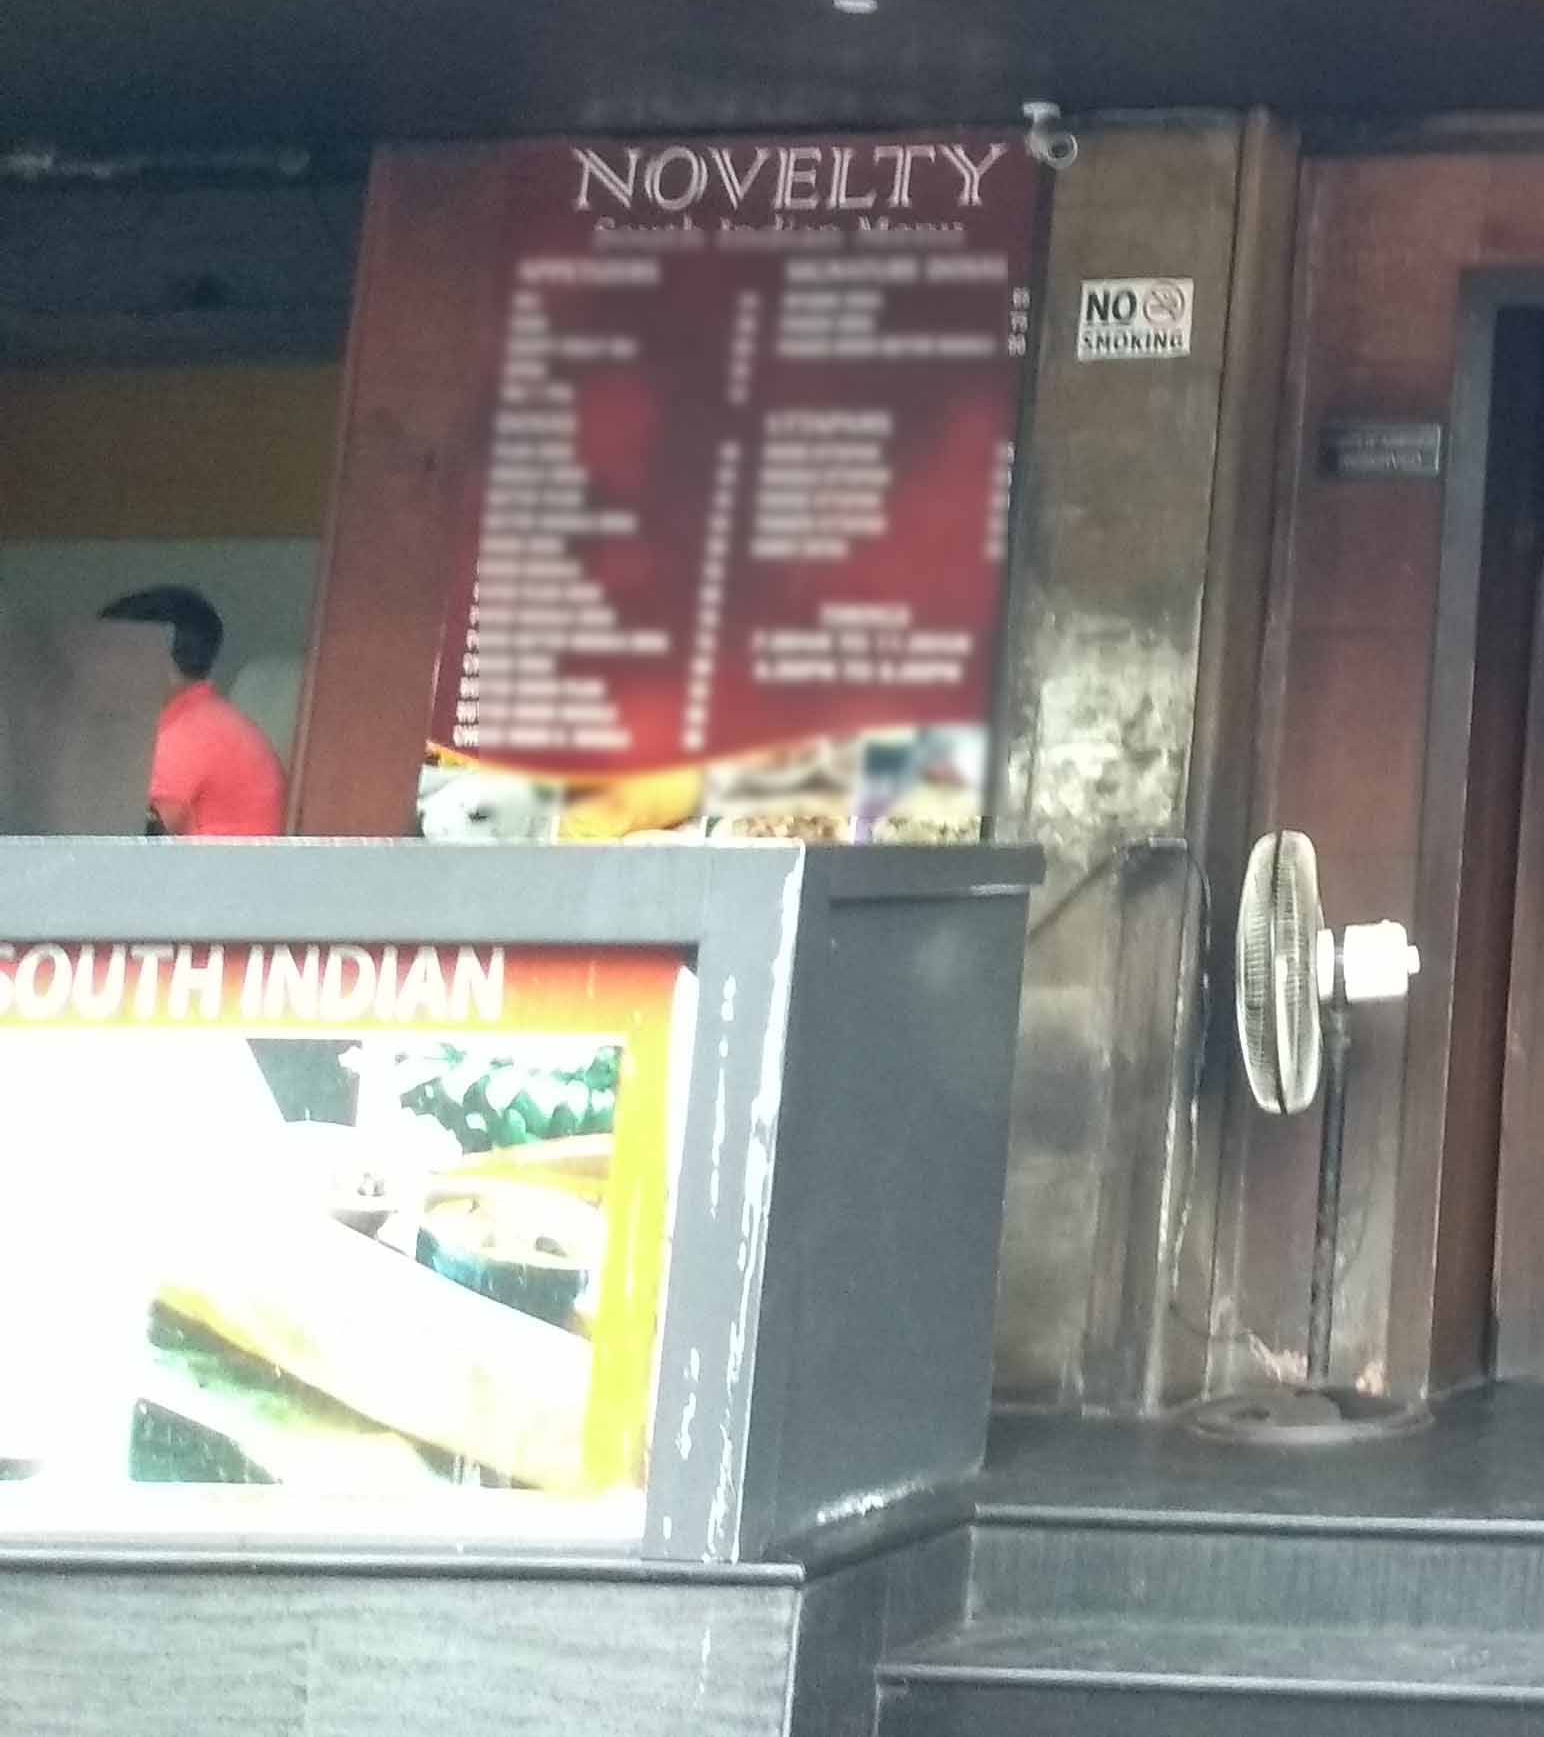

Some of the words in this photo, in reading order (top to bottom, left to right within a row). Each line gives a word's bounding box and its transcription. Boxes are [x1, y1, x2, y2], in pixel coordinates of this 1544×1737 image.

[572, 142, 1007, 211] NOVELTY
[1086, 288, 1138, 324] NO
[1083, 329, 1184, 351] SMOKING
[240, 943, 506, 1021] INDIAN
